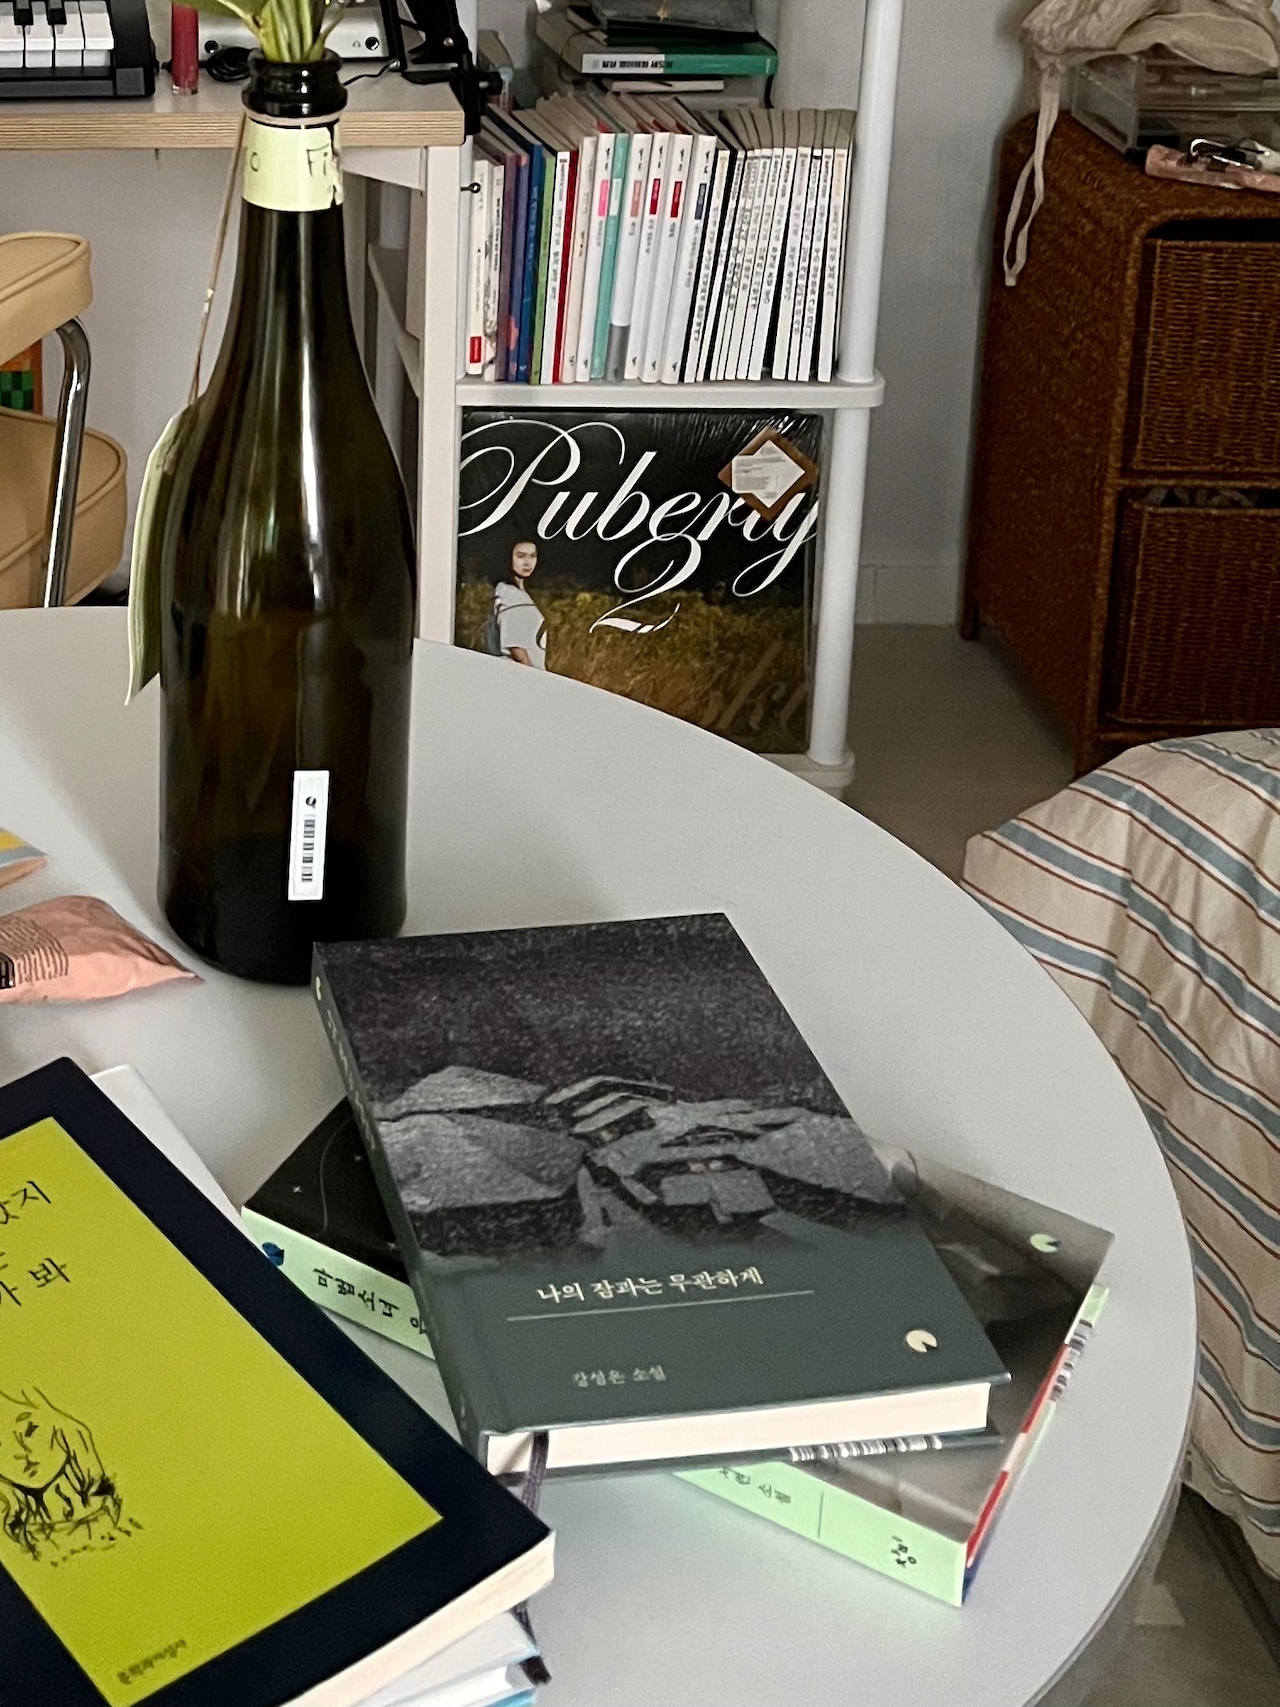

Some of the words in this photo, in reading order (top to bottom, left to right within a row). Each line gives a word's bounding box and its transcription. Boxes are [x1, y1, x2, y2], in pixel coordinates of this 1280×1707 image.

[589, 533, 702, 634] 2
[27, 1257, 71, 1288] 봐
[536, 1281, 585, 1304] 나의
[589, 1276, 663, 1299] 잠과는
[667, 1265, 764, 1293] 무관하게
[631, 1364, 667, 1382] 소설
